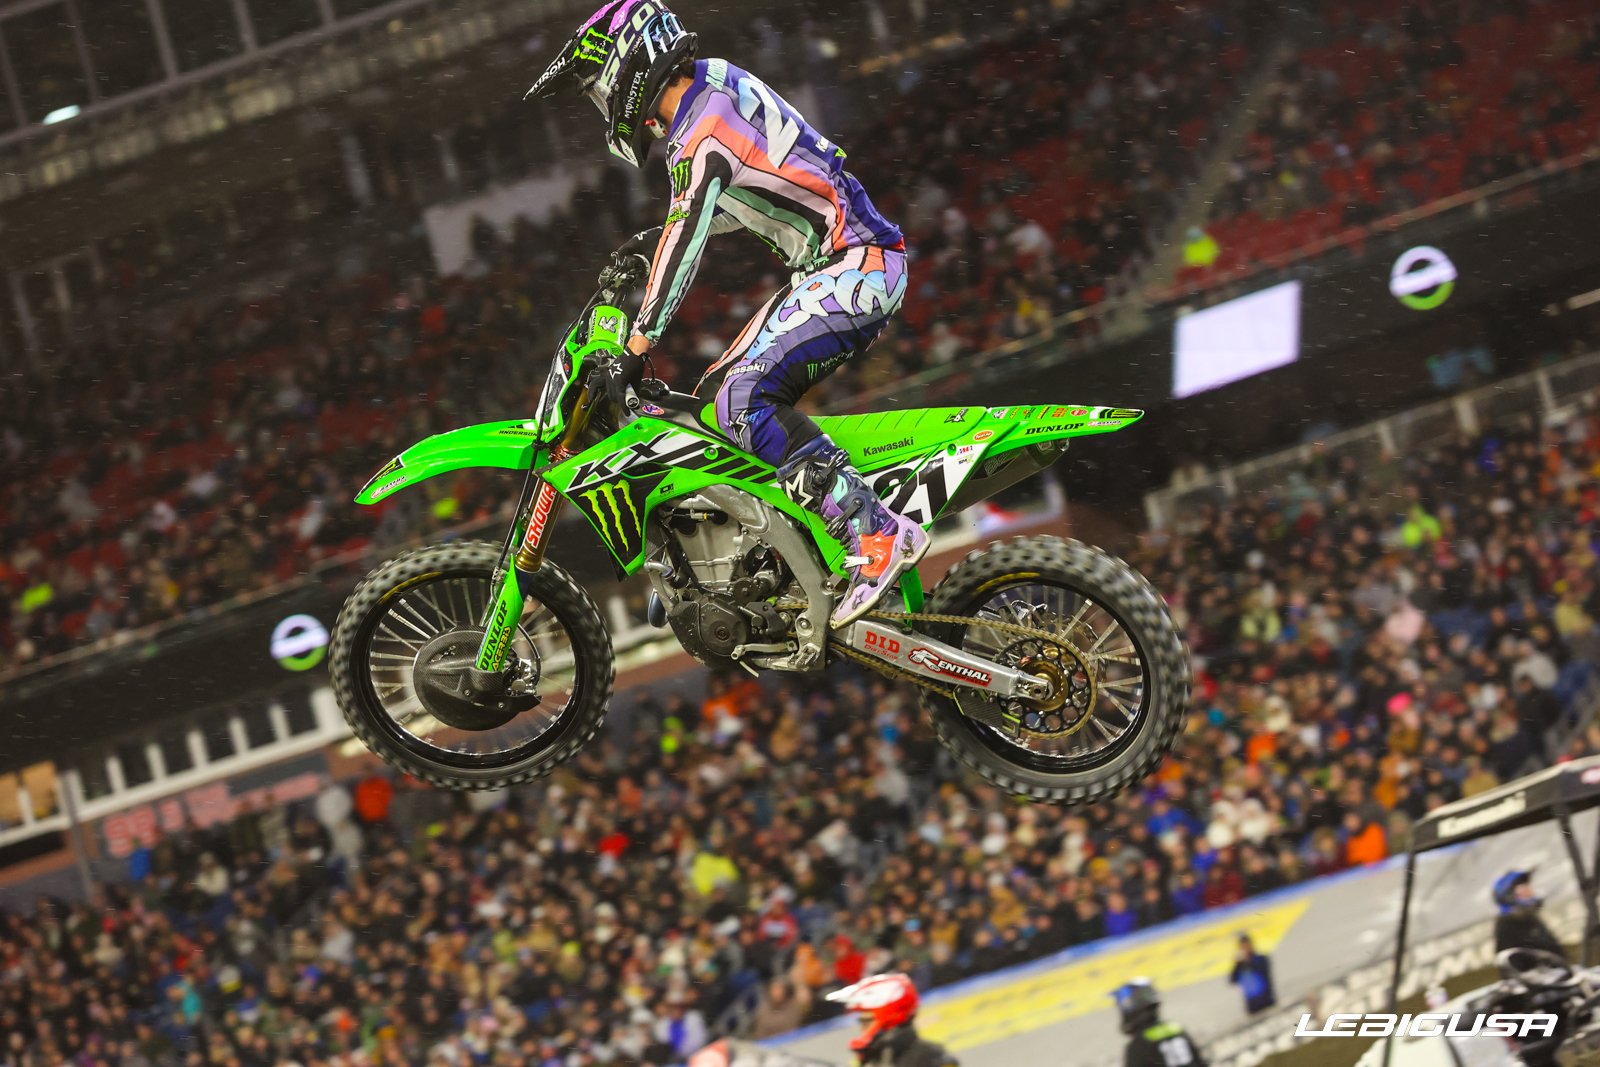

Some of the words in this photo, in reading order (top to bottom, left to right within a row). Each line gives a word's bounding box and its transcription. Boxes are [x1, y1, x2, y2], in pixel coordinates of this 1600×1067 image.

[624, 71, 644, 119] MONSTER
[634, 81, 646, 114] ENERGY
[725, 363, 767, 382] wasaki
[498, 429, 538, 438] ANDERSON
[863, 436, 914, 457] Kawasaki
[1025, 423, 1084, 436] DUNLOP
[566, 429, 674, 490] KX
[873, 457, 948, 525] 21
[526, 482, 557, 549] SHOWA
[479, 599, 508, 671] DUNLOP
[492, 626, 511, 671] ACERBIS
[908, 648, 990, 683] RENTHAL
